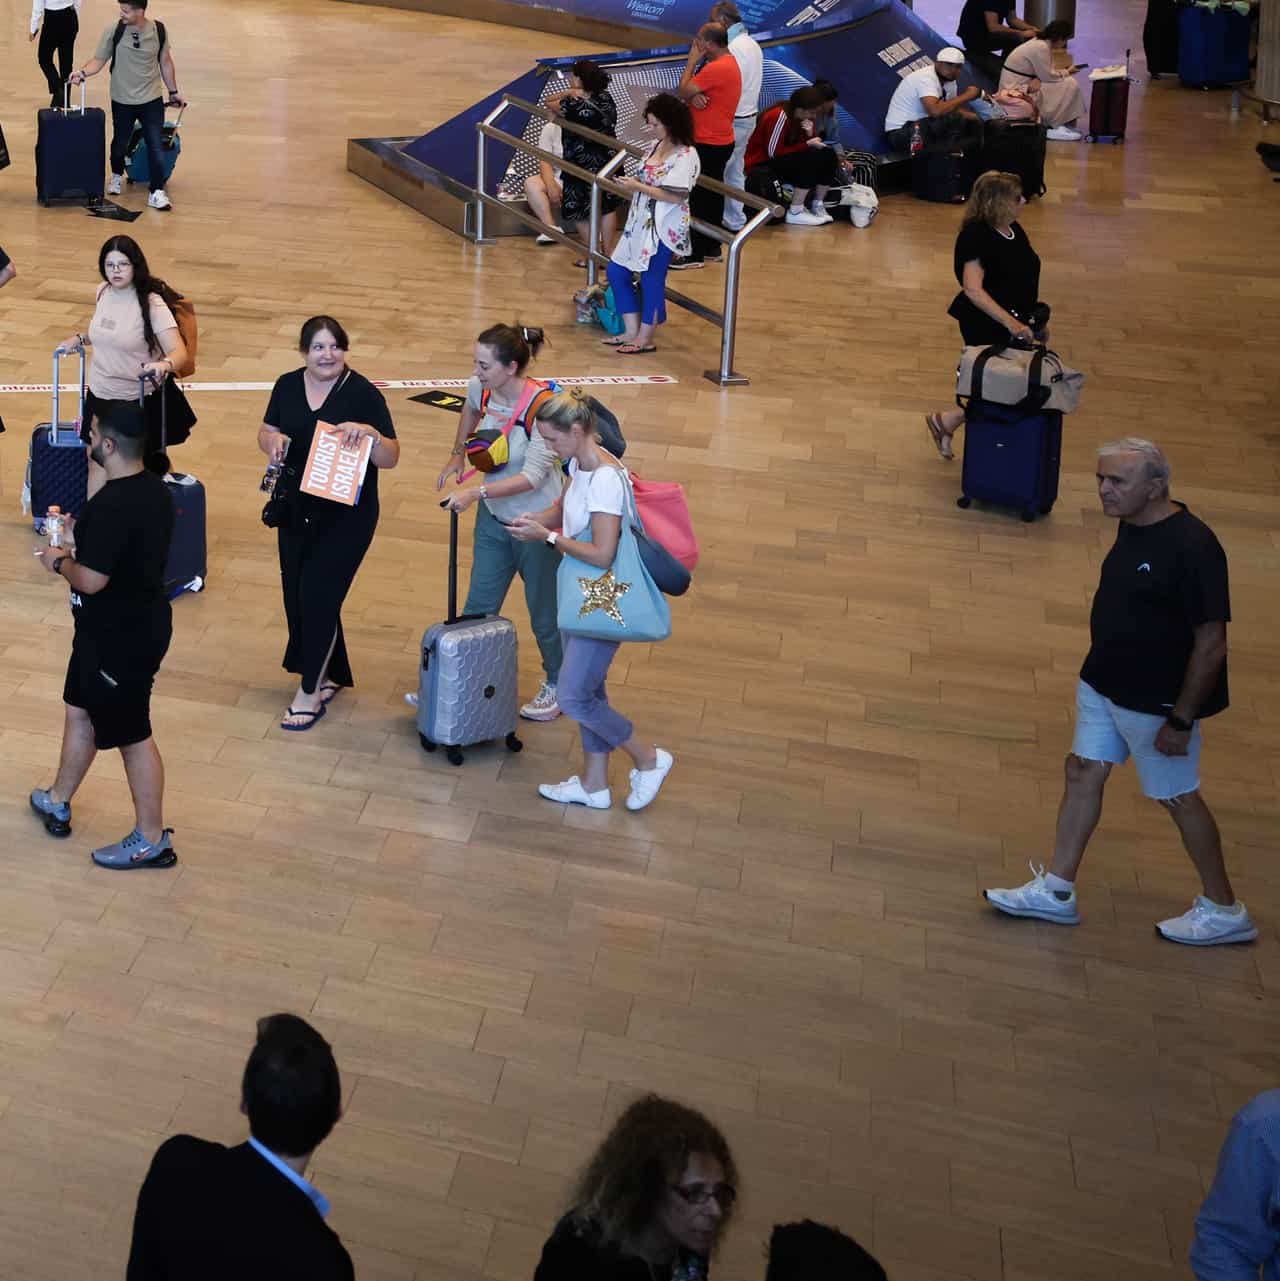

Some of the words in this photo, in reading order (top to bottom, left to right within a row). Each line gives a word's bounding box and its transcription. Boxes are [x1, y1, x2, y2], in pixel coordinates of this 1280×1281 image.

[626, 0, 665, 16] Welkom
[307, 430, 339, 491] TOURIST
[330, 444, 361, 499] ISRAEL
